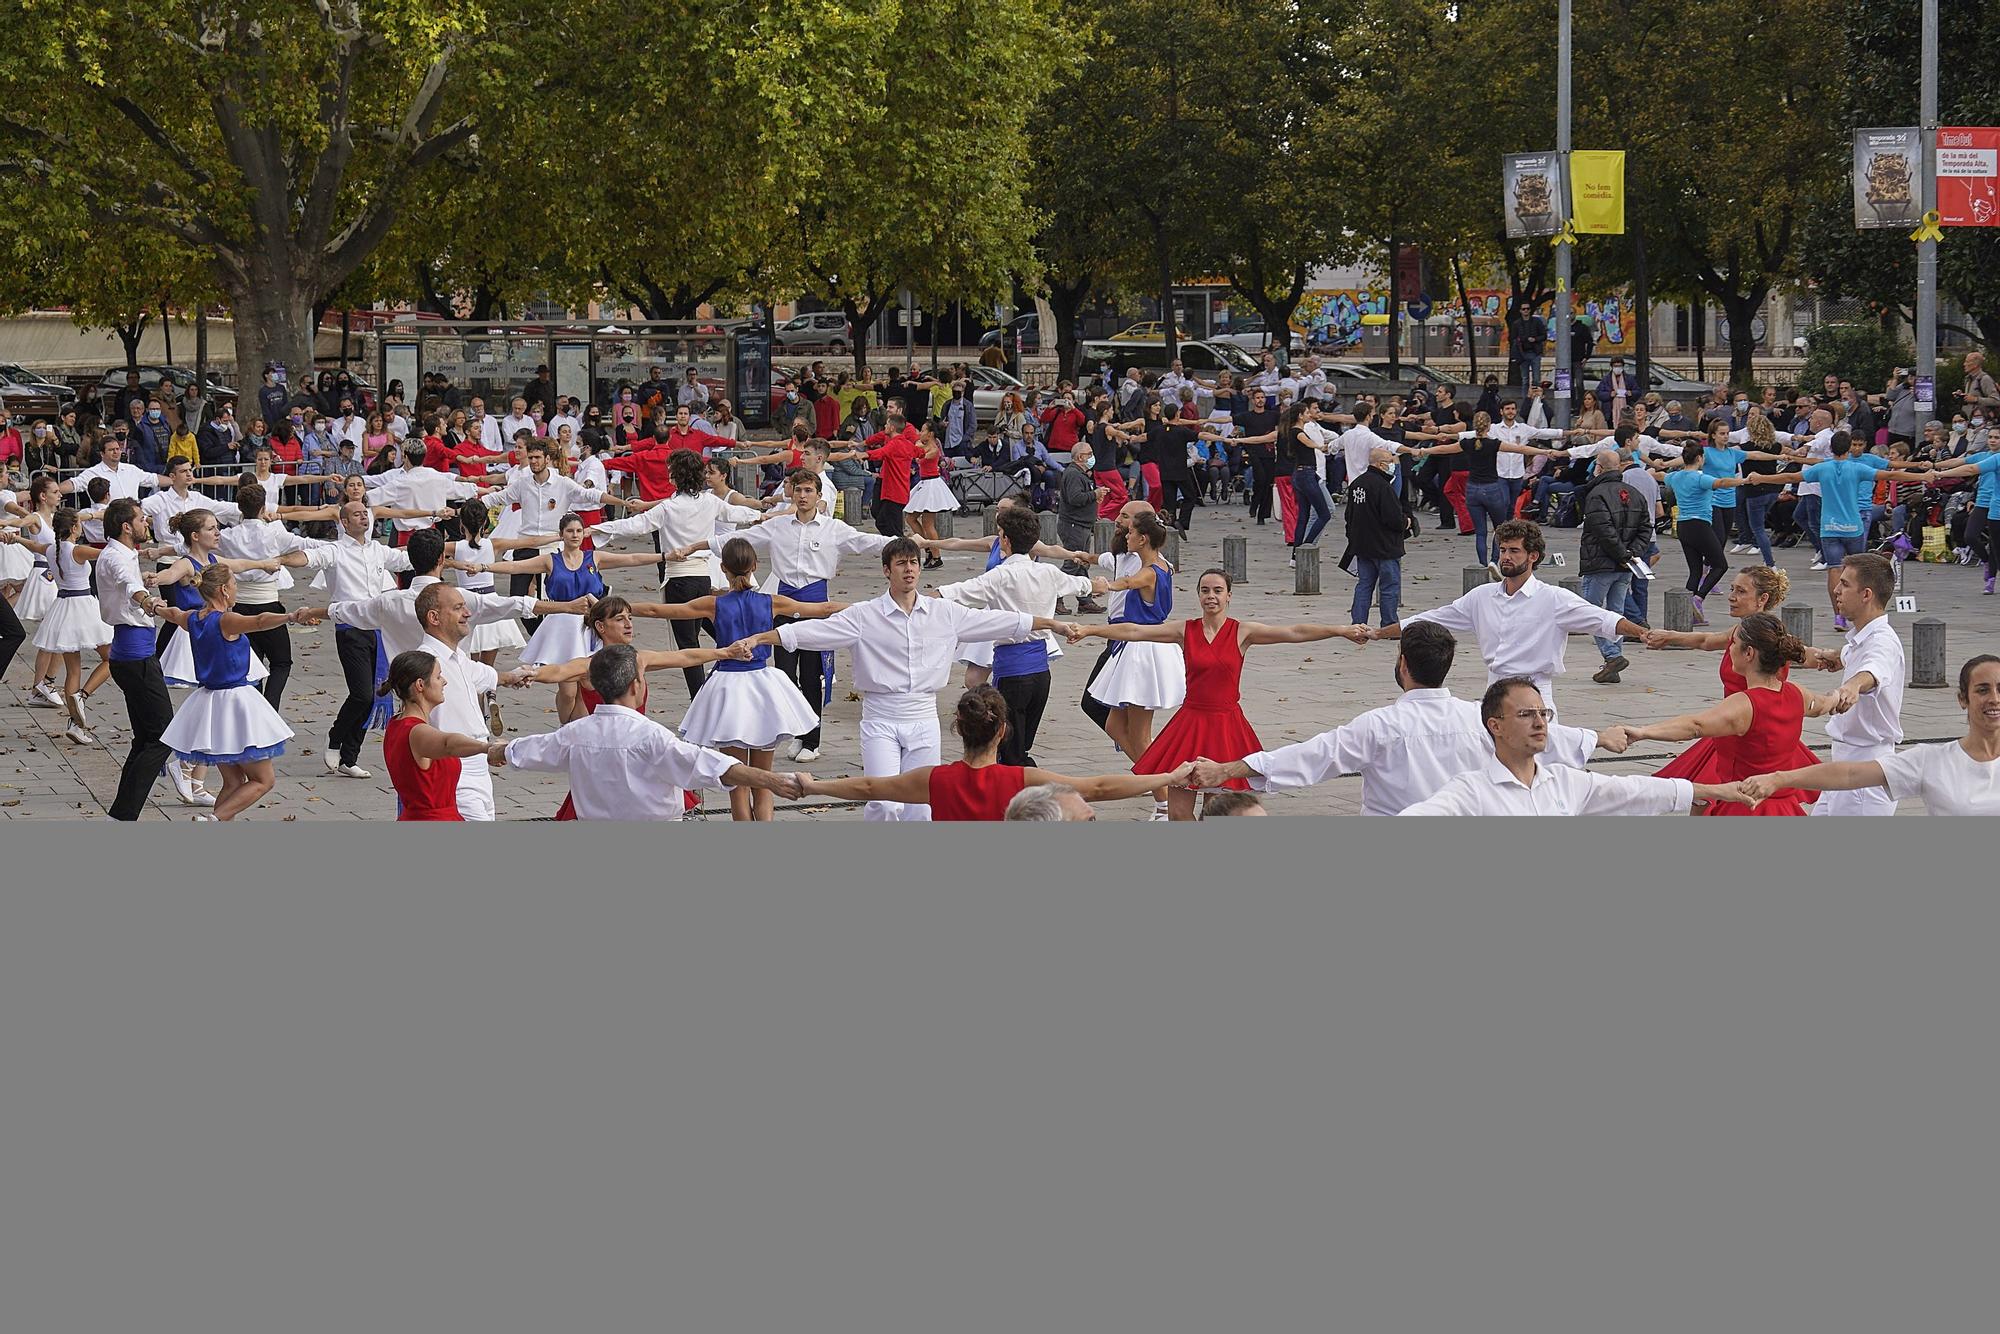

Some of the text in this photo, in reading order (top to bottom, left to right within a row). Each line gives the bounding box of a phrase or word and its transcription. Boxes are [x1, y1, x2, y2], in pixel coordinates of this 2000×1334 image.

[1942, 160, 1973, 168] Temporada
[1585, 183, 1611, 191] No fem
[1899, 599, 1912, 610] 11
